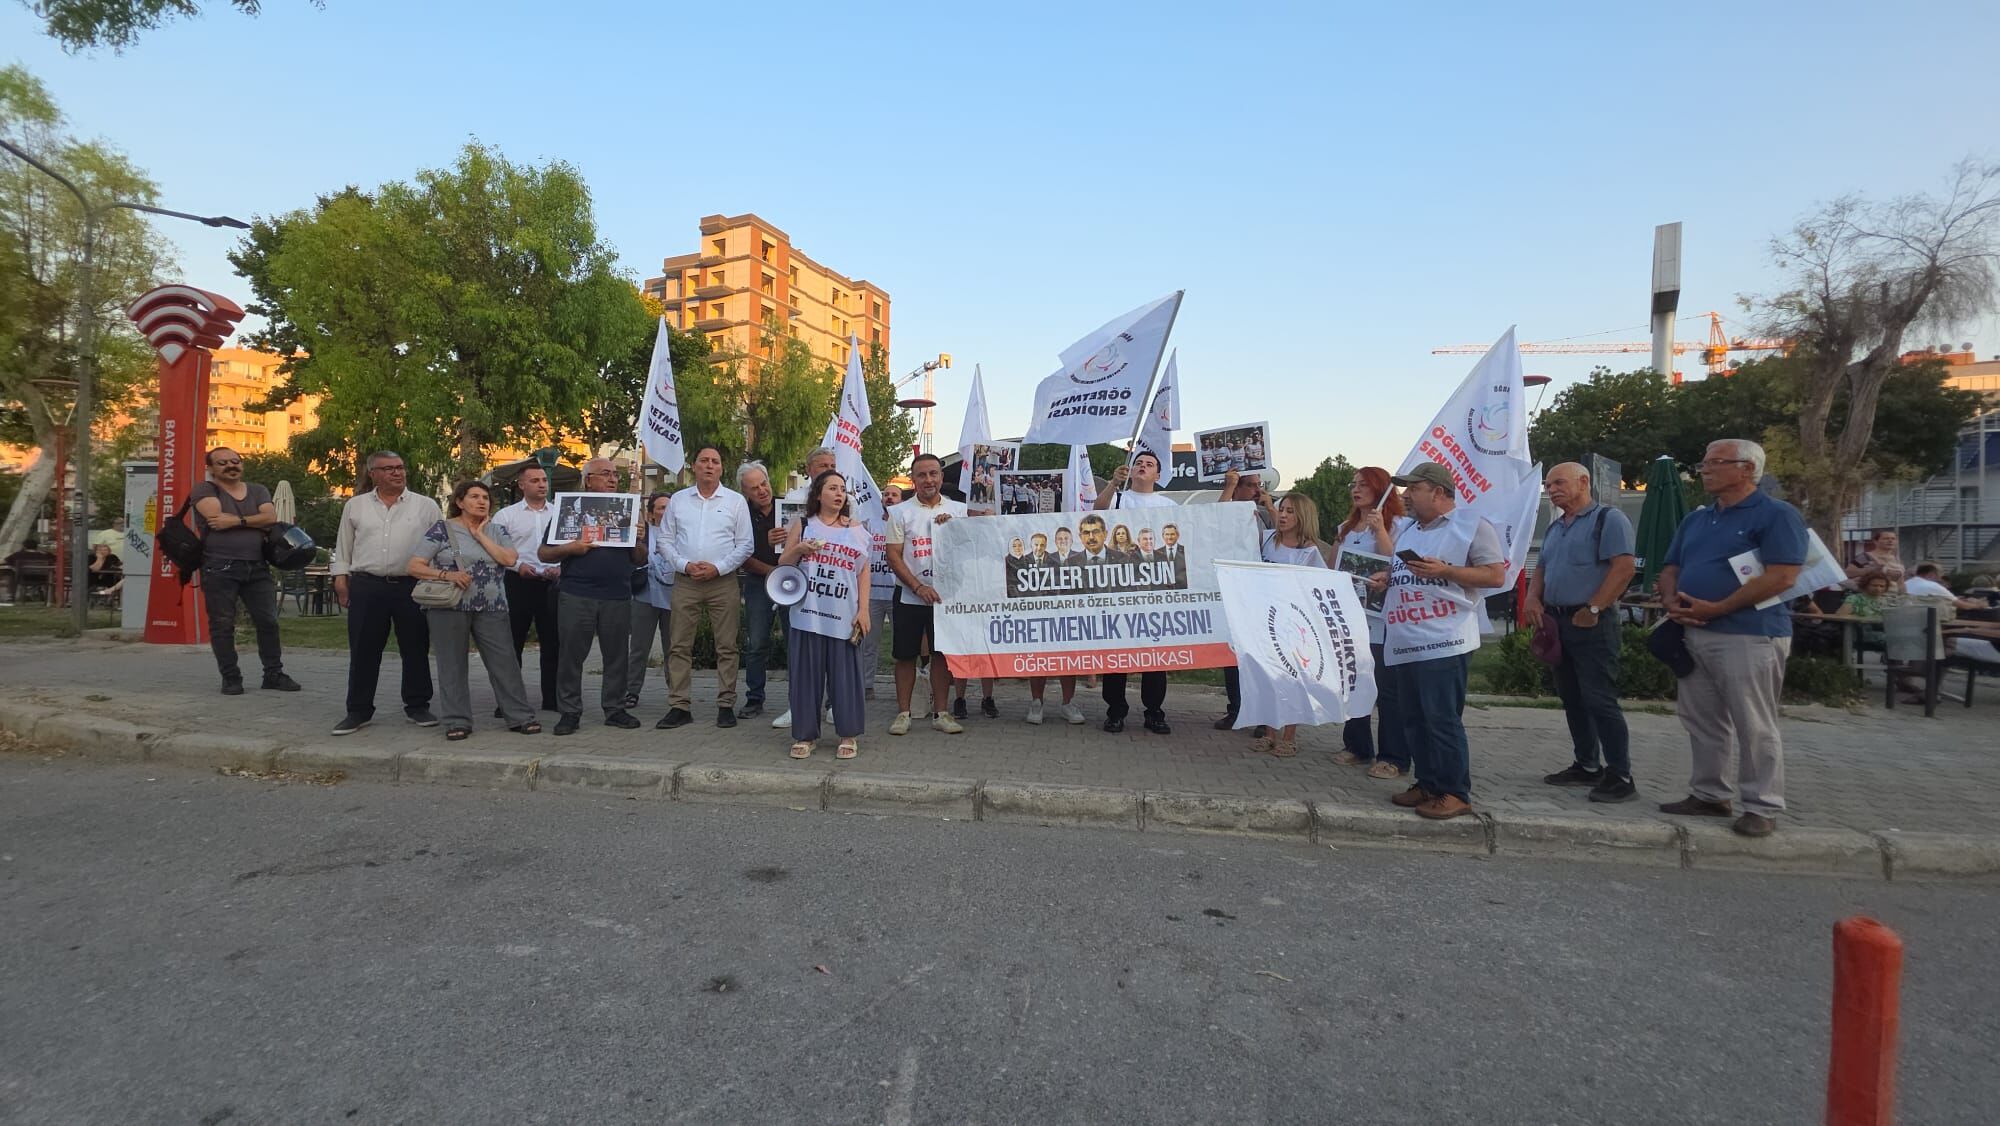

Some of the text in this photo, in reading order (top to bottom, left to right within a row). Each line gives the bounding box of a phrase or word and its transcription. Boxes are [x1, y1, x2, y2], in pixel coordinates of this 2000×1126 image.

[162, 419, 176, 492] BAYRAKLI
[1431, 424, 1493, 494] ÖĞRETMEN
[1419, 440, 1477, 504] SENDİKASI
[816, 566, 836, 579] İLE
[1016, 560, 1176, 592] SÖZLER TUTULSUN
[808, 578, 849, 600] ÜÇLÜ!
[944, 591, 1222, 615] MÜLAKAT MAĞDURLARI & ÖZEL SEKTÖR ÖĞRETME
[1400, 589, 1425, 604] İLE
[1388, 598, 1457, 626] GÜÇLÜ!
[989, 609, 1212, 645] ÖĞRETMENLİK YAŞASIN!
[1013, 648, 1194, 673] ÖĞRETMEN SENDİKASI
